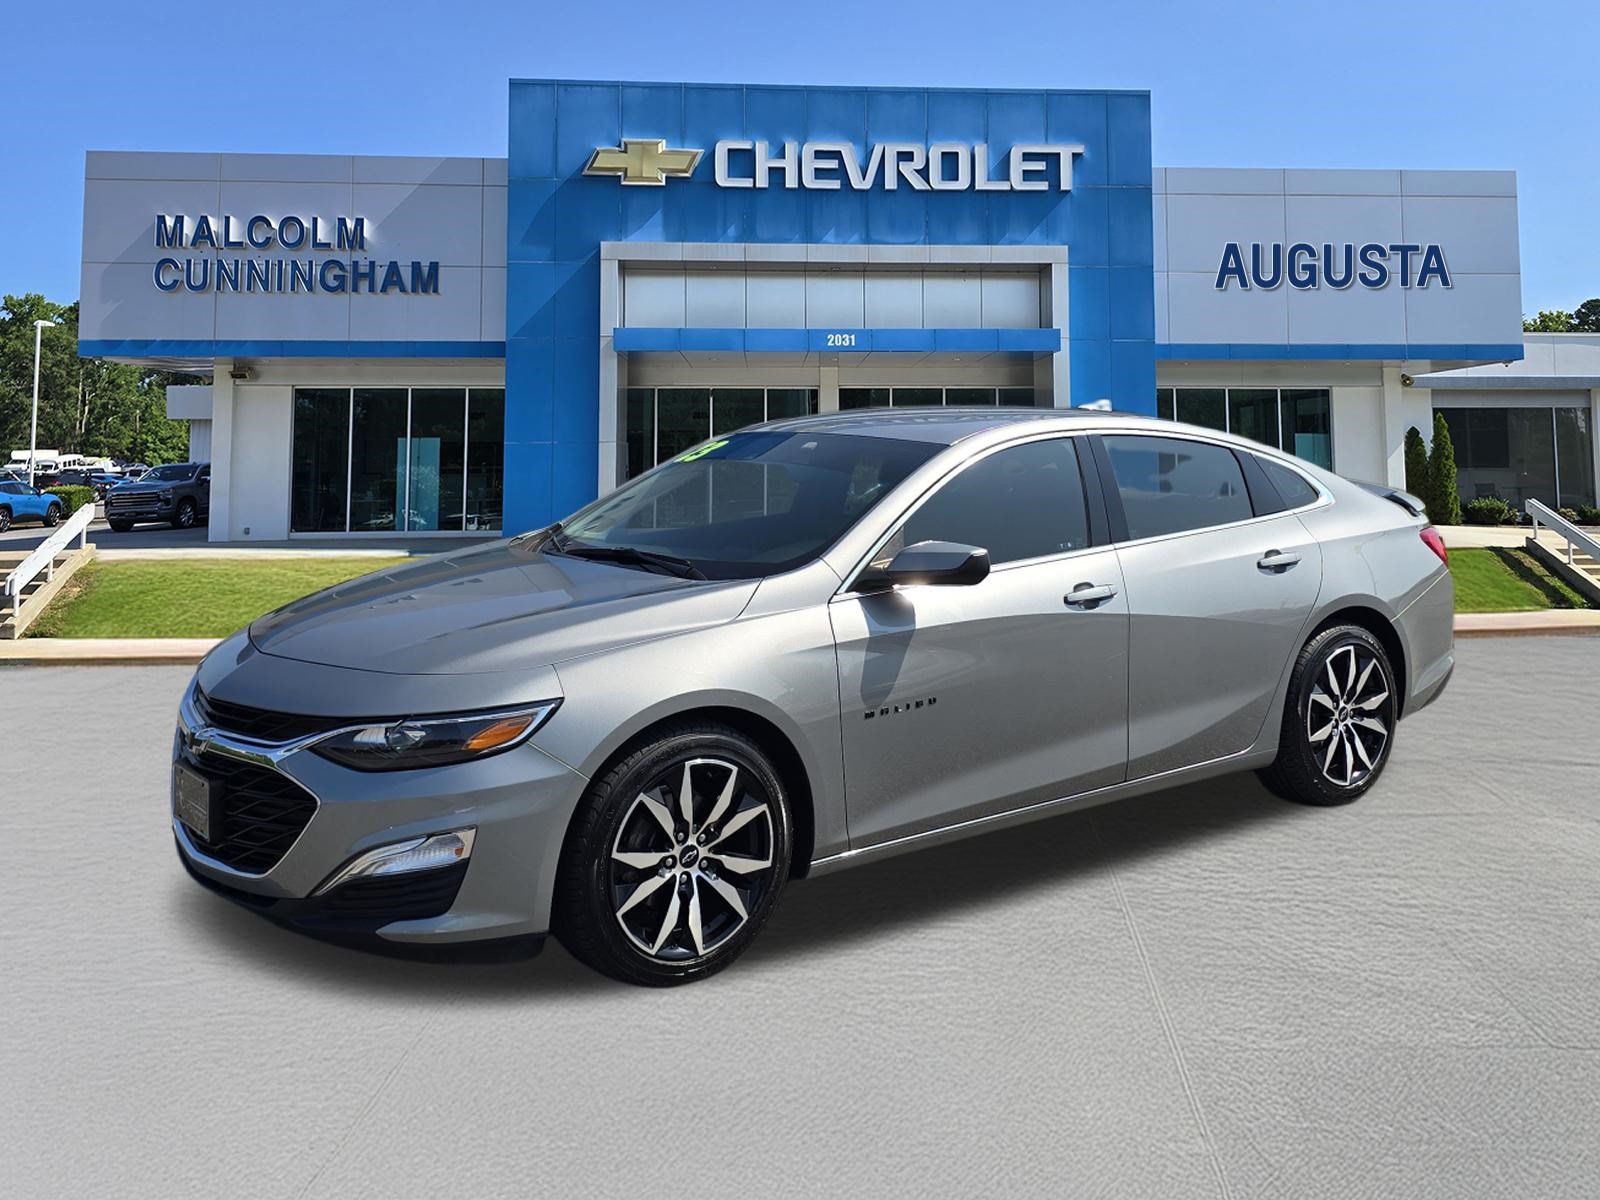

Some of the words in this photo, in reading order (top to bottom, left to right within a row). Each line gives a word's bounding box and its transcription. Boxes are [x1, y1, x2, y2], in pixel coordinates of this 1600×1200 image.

[714, 139, 1084, 191] CHEVROLET
[154, 214, 366, 250] MALCOLM
[152, 257, 440, 295] CUNNINGHAM
[1214, 241, 1453, 290] AUGUSTA
[826, 333, 856, 346] 2031
